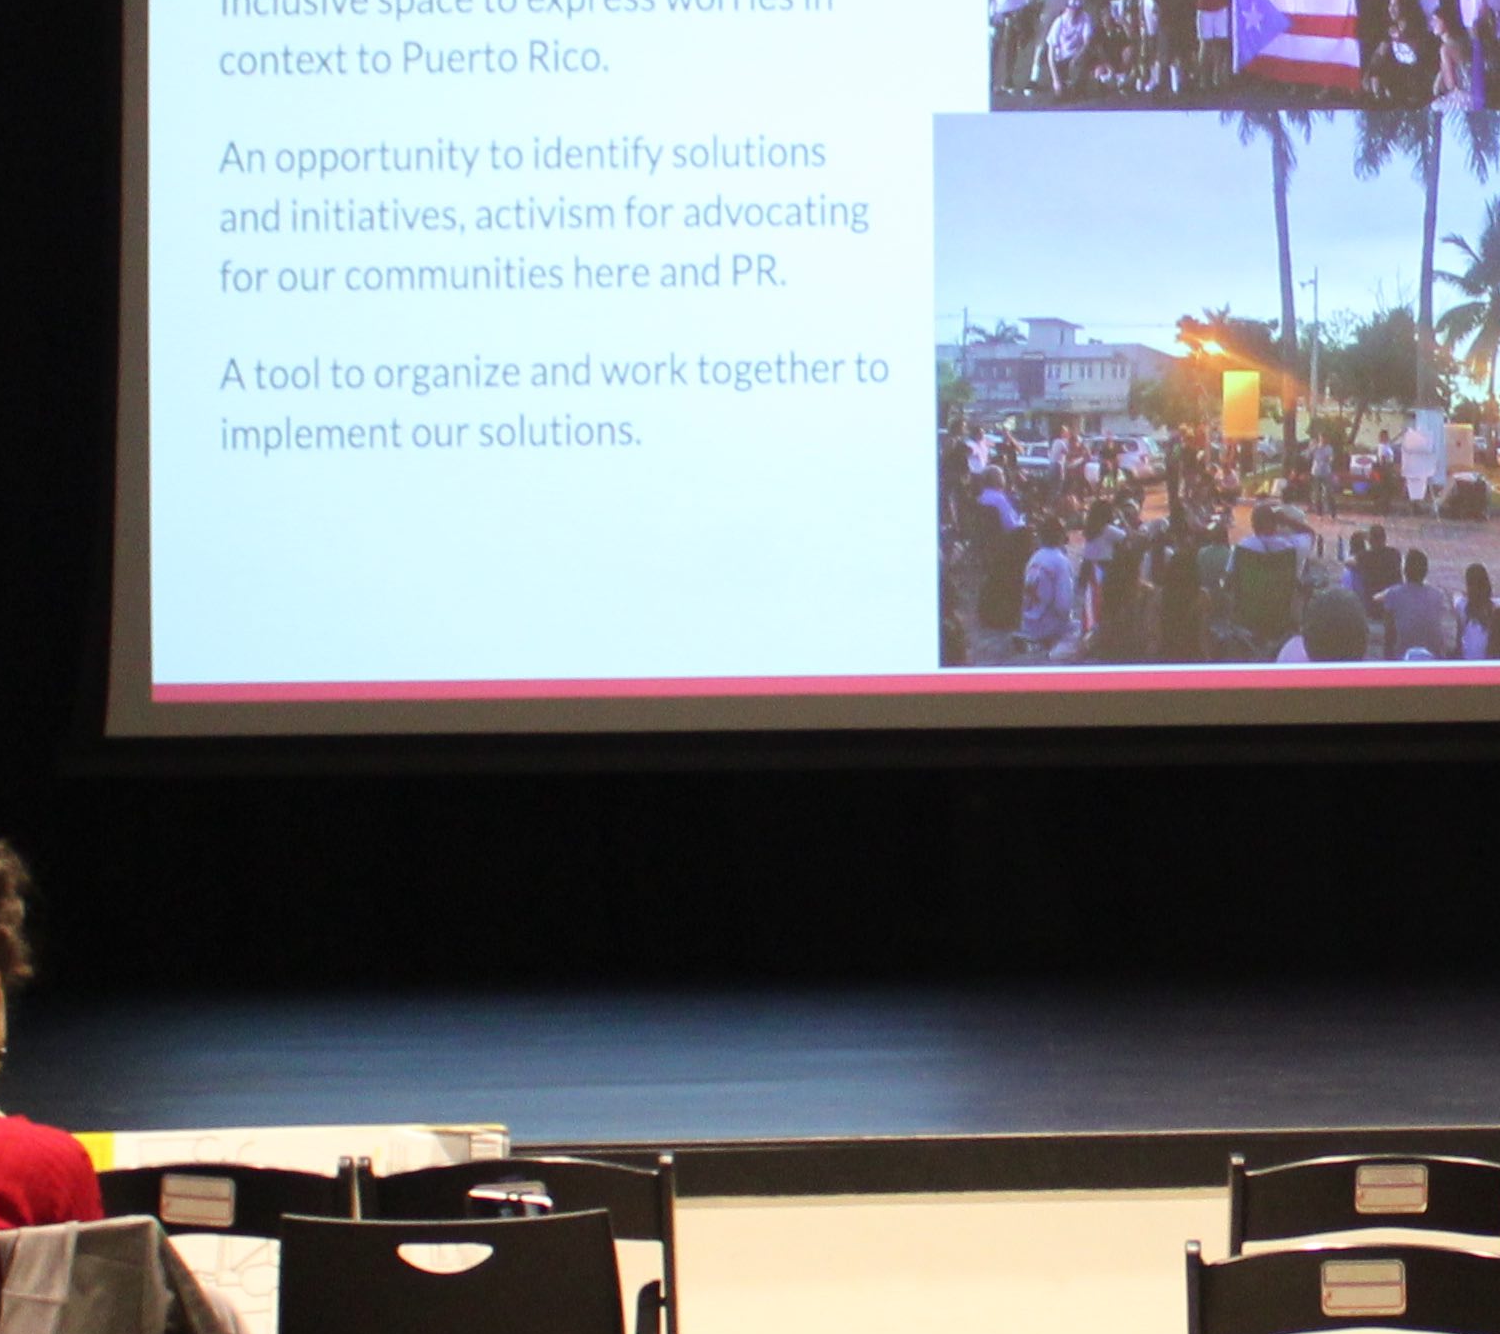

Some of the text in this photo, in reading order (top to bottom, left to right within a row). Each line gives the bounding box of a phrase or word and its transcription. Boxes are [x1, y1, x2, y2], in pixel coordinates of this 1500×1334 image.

[218, 39, 609, 77] context to Puerto Rico.
[218, 134, 827, 181] An opportunity to identify solutions
[219, 193, 870, 235] and initiatives, activism for advocating
[219, 253, 786, 294] for our communities here and PR.
[219, 350, 890, 397] A tool to organize and work together to
[221, 412, 642, 458] implement our solutions.
